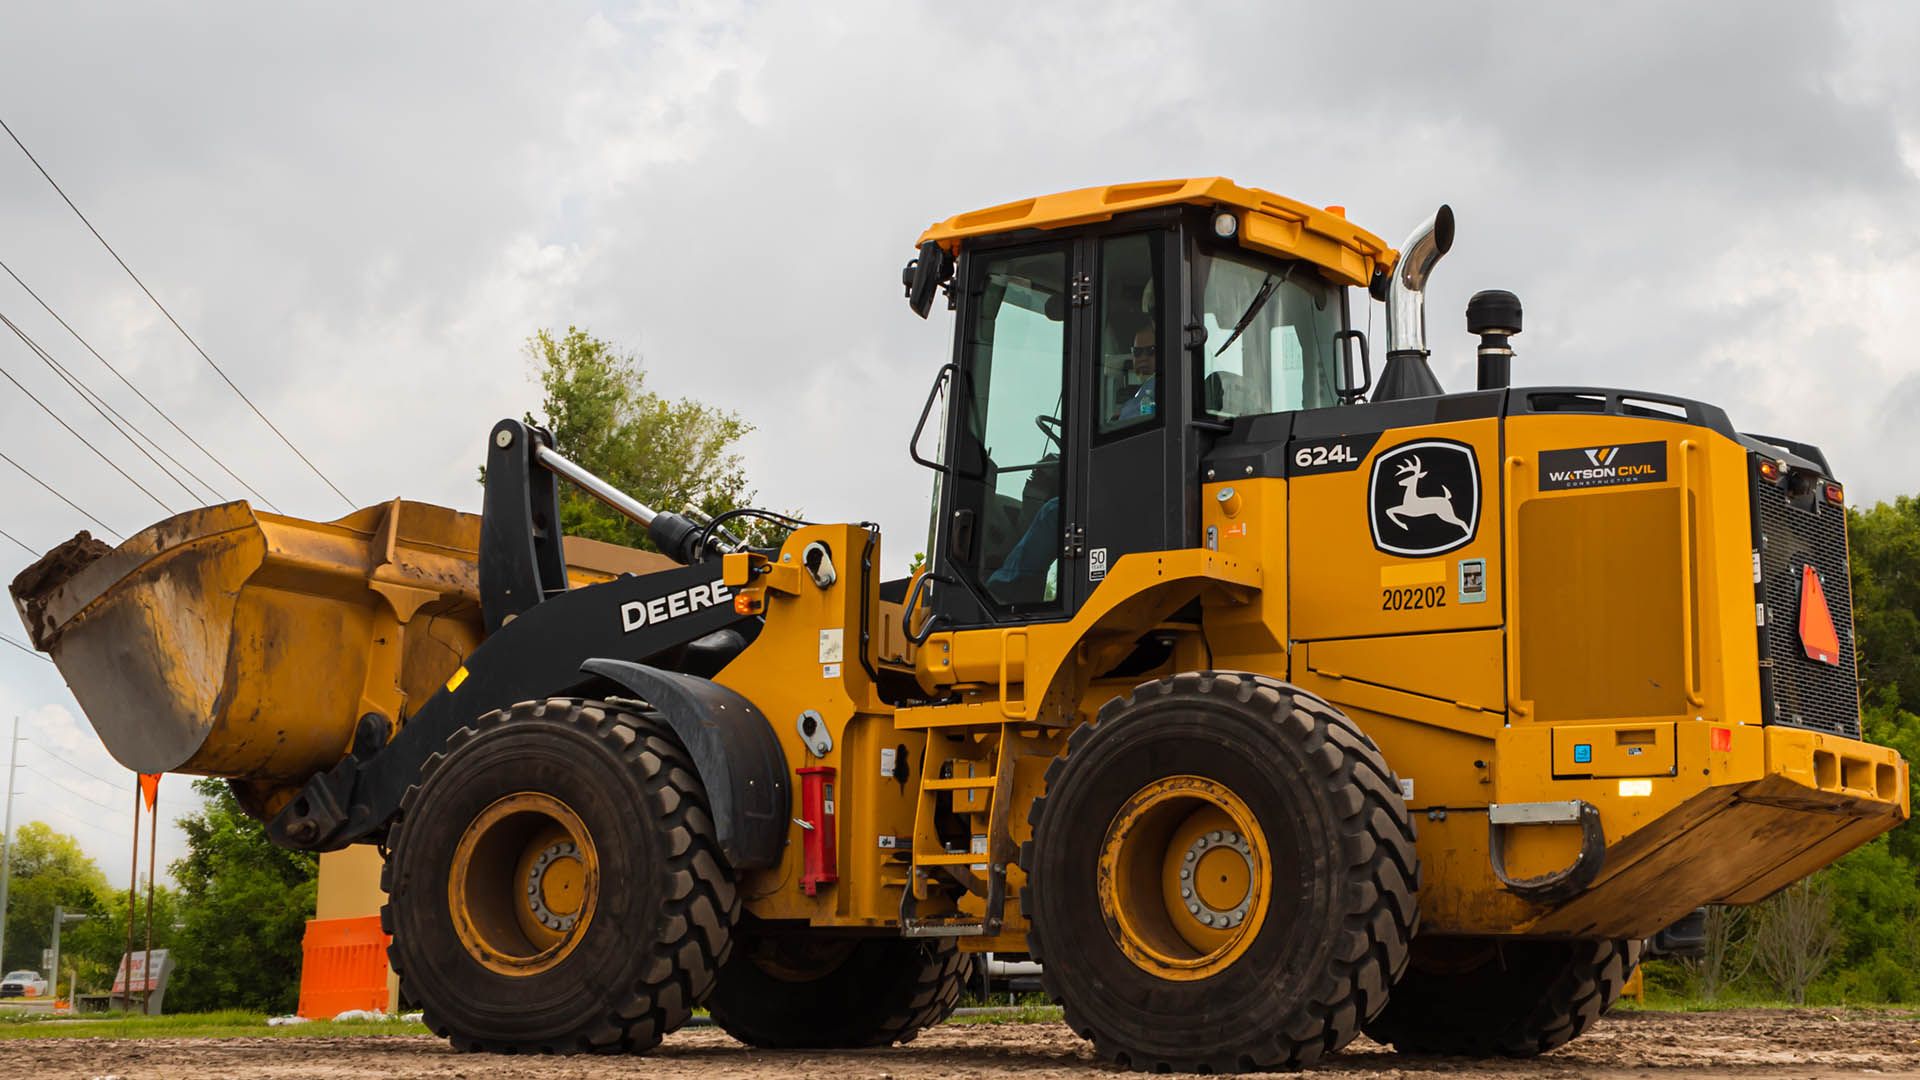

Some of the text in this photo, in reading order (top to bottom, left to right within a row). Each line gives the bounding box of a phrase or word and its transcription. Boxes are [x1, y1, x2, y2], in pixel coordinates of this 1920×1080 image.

[1295, 444, 1358, 467] 624L
[1549, 464, 1656, 482] WATSON CIVIL
[1566, 477, 1638, 487] CONSTRUCTION
[1091, 550, 1105, 565] 50
[621, 579, 733, 632] DEERE
[1382, 585, 1446, 610] 202202
